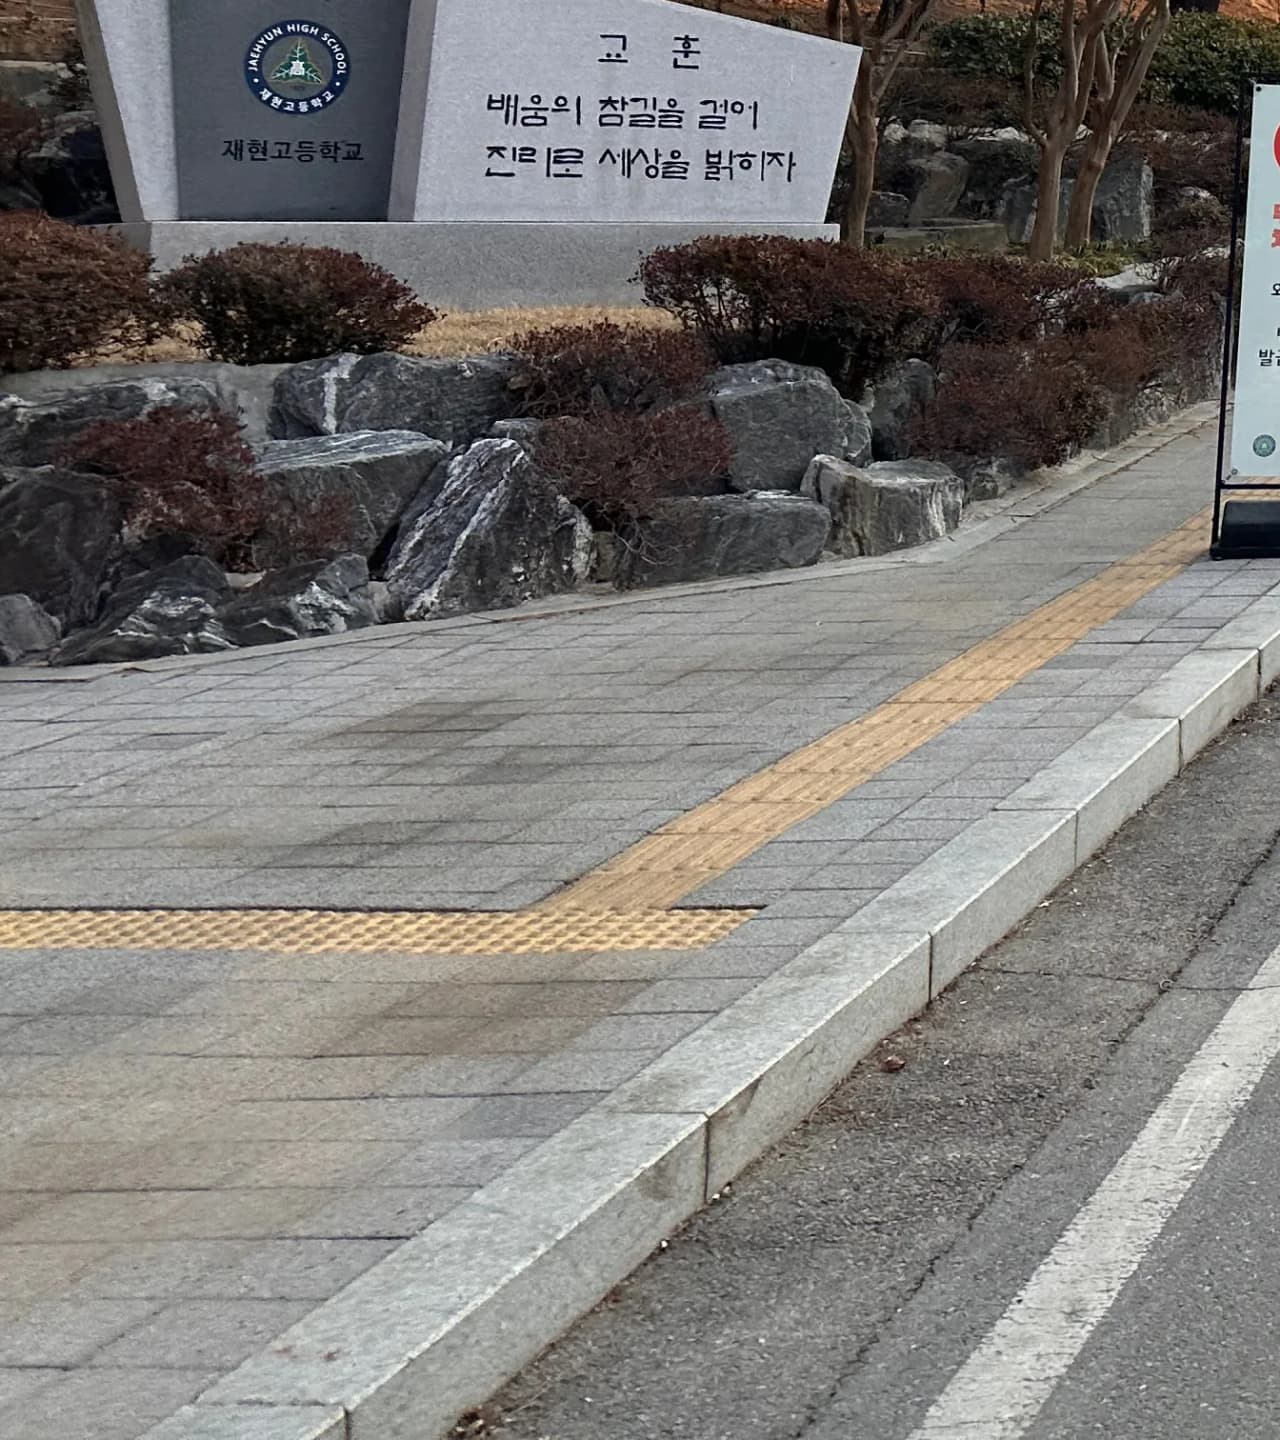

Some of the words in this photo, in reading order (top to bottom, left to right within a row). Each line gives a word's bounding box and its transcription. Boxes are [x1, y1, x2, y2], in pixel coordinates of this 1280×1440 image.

[248, 26, 283, 72] JAEHYUN
[286, 23, 319, 35] HIGH
[321, 33, 347, 75] SCHOOL
[259, 87, 335, 113] 재현고등학교
[486, 93, 582, 127] 배움의
[598, 96, 685, 129] 참길을
[698, 99, 758, 130] 걸어
[221, 138, 364, 163] 재현고등학교
[485, 146, 584, 178] 진리로
[598, 148, 690, 180] 세상을
[703, 148, 797, 182] 밝히자
